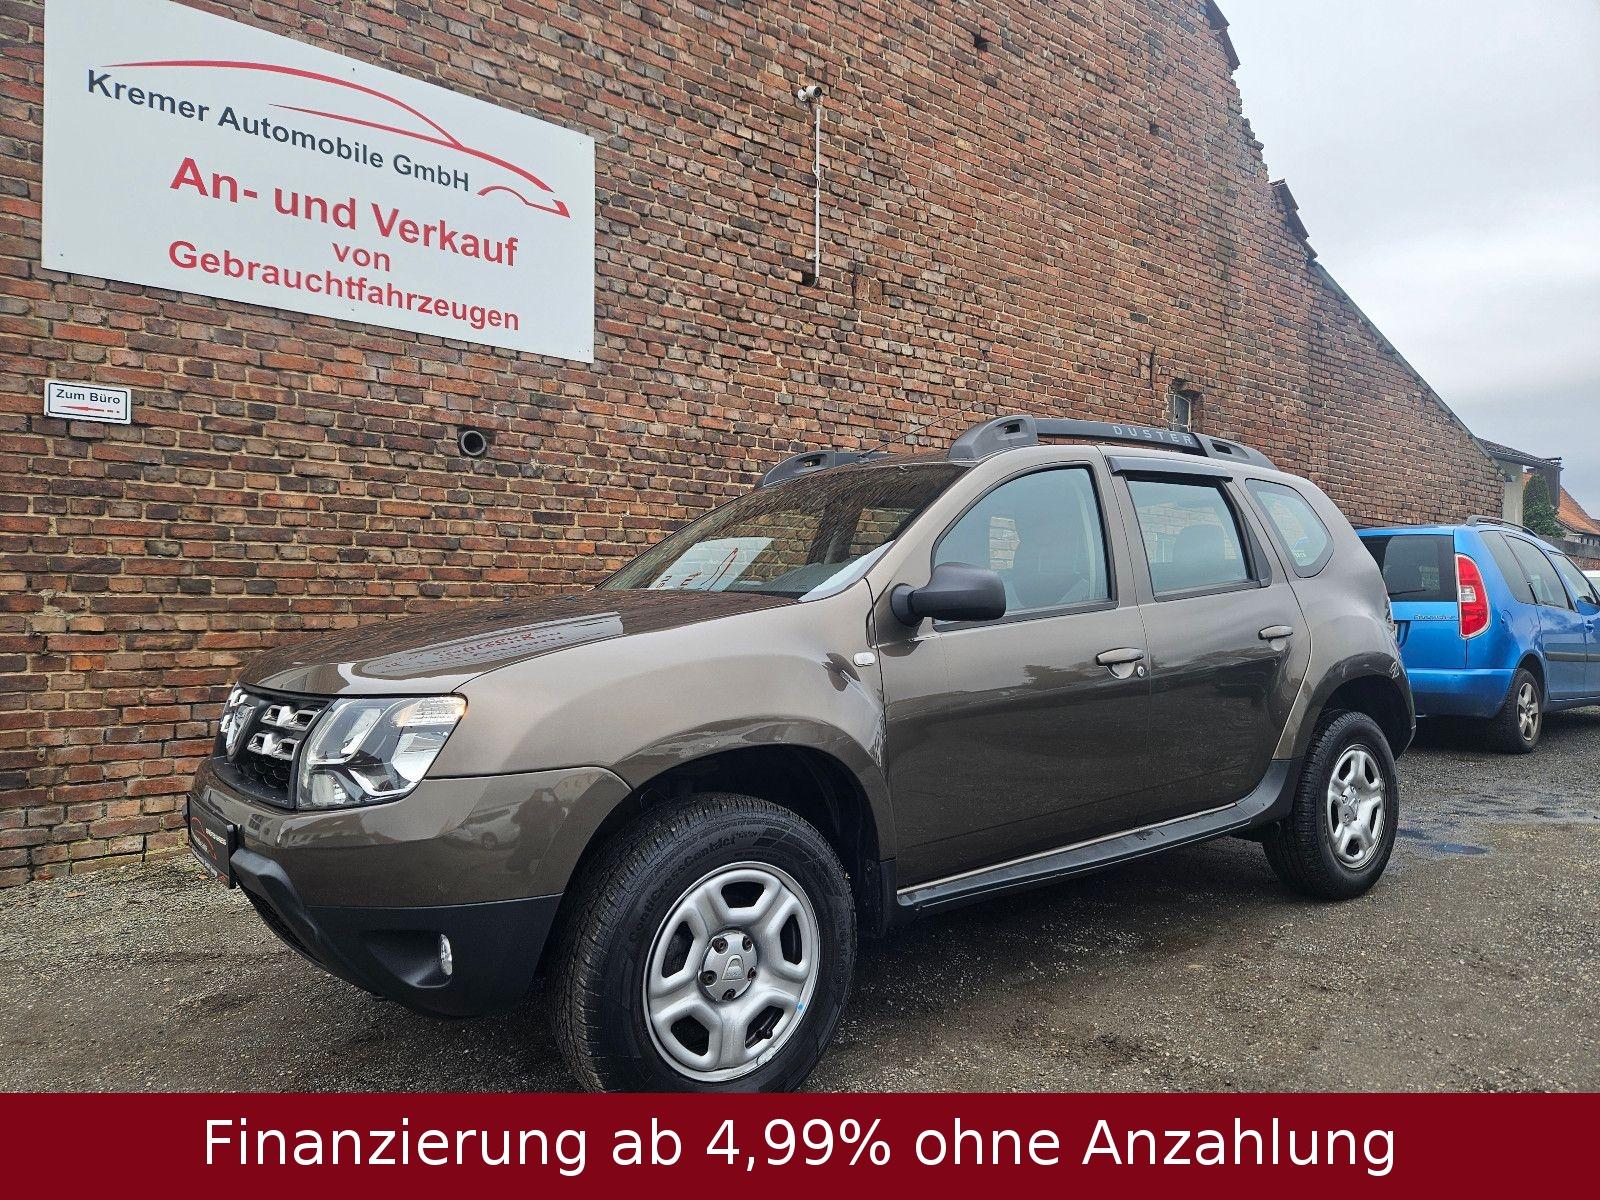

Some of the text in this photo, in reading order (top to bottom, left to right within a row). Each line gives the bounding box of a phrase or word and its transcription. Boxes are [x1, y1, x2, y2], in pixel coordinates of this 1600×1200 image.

[88, 69, 470, 192] Kremer Automobile GmbH
[171, 157, 519, 266] An- und Verkauf
[168, 240, 520, 331] Gebrauchtfahrzeugen
[333, 242, 391, 271] von
[56, 388, 121, 405] Zum Büro
[1112, 425, 1193, 445] DUSTER
